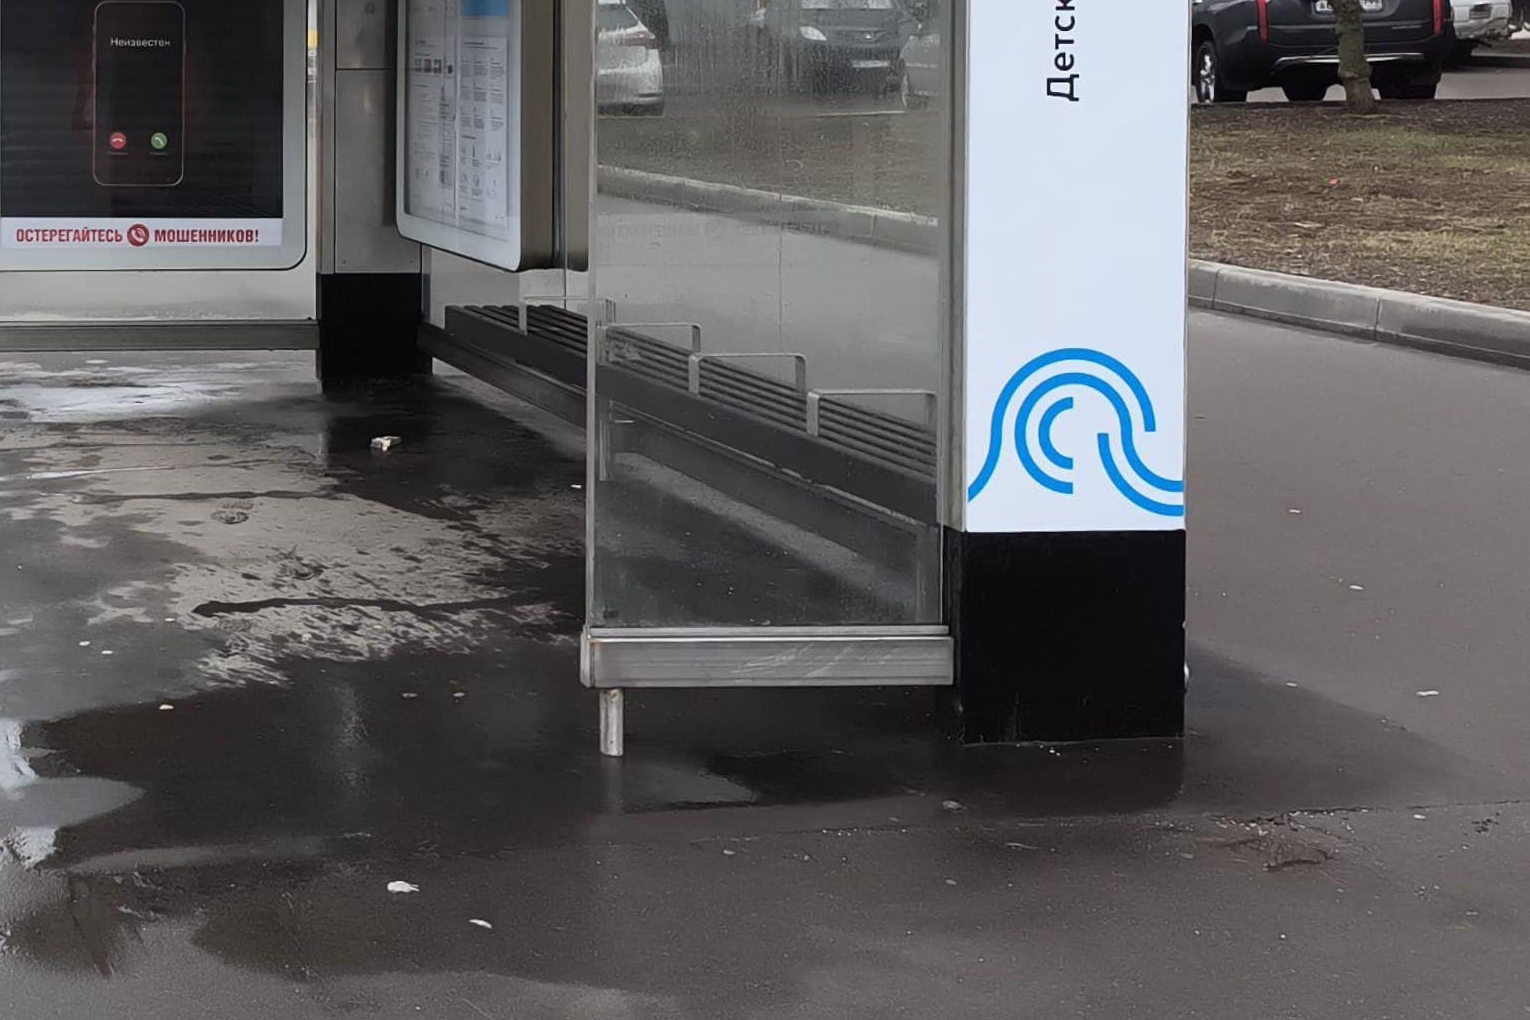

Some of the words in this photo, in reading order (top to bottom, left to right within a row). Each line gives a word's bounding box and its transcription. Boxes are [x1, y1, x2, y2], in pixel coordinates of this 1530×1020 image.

[110, 37, 171, 47] Неизвестен
[16, 227, 123, 243] ОСТЕРЕГАЙТЕСЬ
[154, 229, 259, 243] МОШЕННИКОВ!
